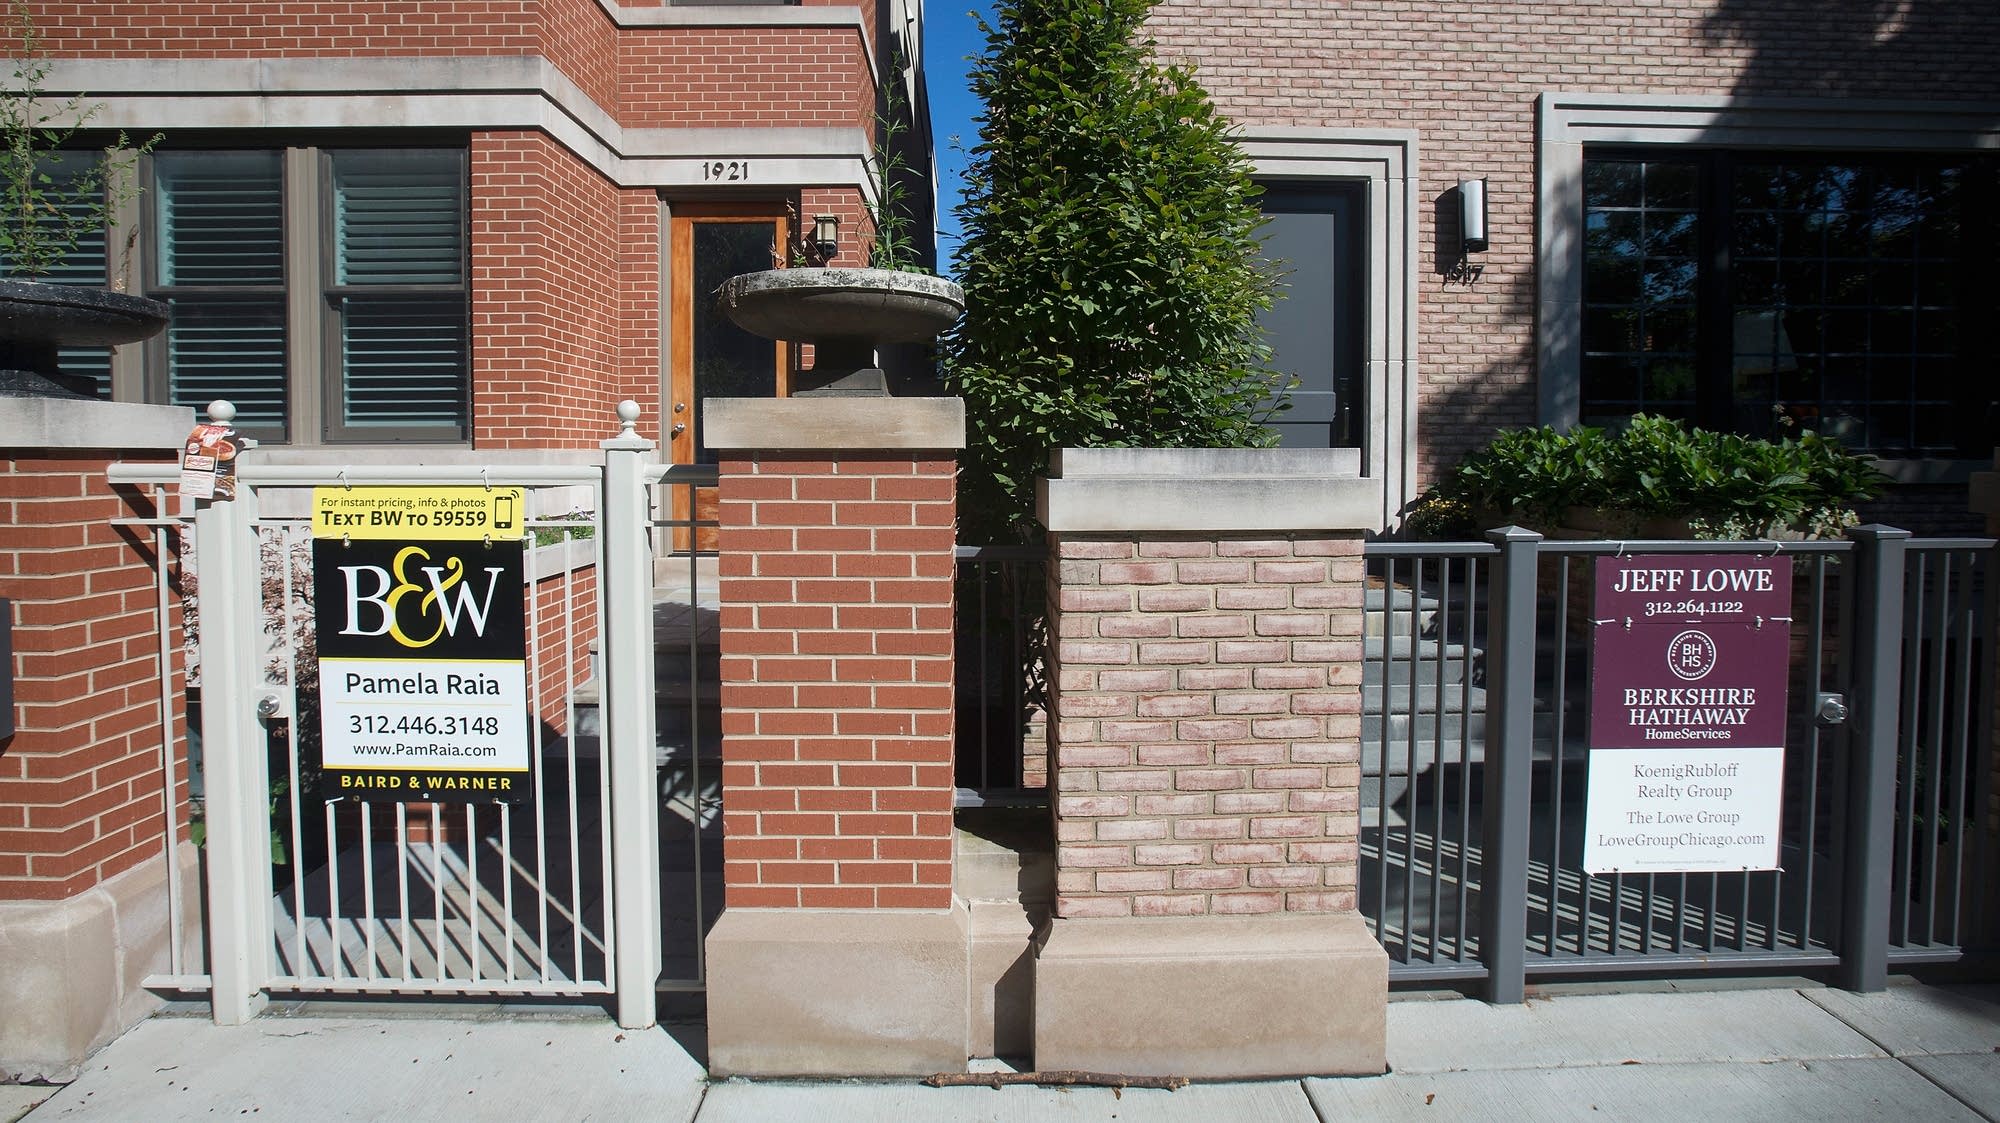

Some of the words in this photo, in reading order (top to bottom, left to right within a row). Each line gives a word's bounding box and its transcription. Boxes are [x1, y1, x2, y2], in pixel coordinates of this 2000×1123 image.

[703, 161, 748, 181] 1921
[321, 497, 339, 507] For
[341, 497, 375, 507] instant
[378, 497, 416, 510] pricing,
[418, 497, 438, 507] info
[440, 498, 449, 507] &
[451, 498, 486, 509] photos
[371, 511, 403, 526] BW
[433, 510, 487, 526] 59559
[1614, 569, 1684, 592] JEFF
[1690, 569, 1774, 592] LOWE
[1645, 599, 1743, 616] 312.264.1122
[1682, 643, 1702, 655] BH
[1682, 655, 1702, 667] HS
[346, 673, 439, 694] Pamela
[447, 673, 500, 695] Raia
[1624, 688, 1756, 706] BERKSHIRE
[1629, 708, 1750, 726] HATHAWAY
[350, 715, 499, 736] 312.446.3148
[1645, 728, 1731, 740] HomeServices
[353, 743, 497, 757] www.PamRaia.com
[1634, 762, 1740, 780] KoenigRubloff
[341, 775, 401, 789] BAIRD
[408, 776, 420, 789] &
[427, 776, 512, 790] WARNER
[1638, 784, 1683, 801] Realty
[1687, 784, 1733, 801] Group
[1627, 811, 1653, 825] The
[1657, 810, 1693, 825] Lowe
[1697, 810, 1740, 826] Group
[1599, 833, 1765, 849] LoweGroupChicago.com
